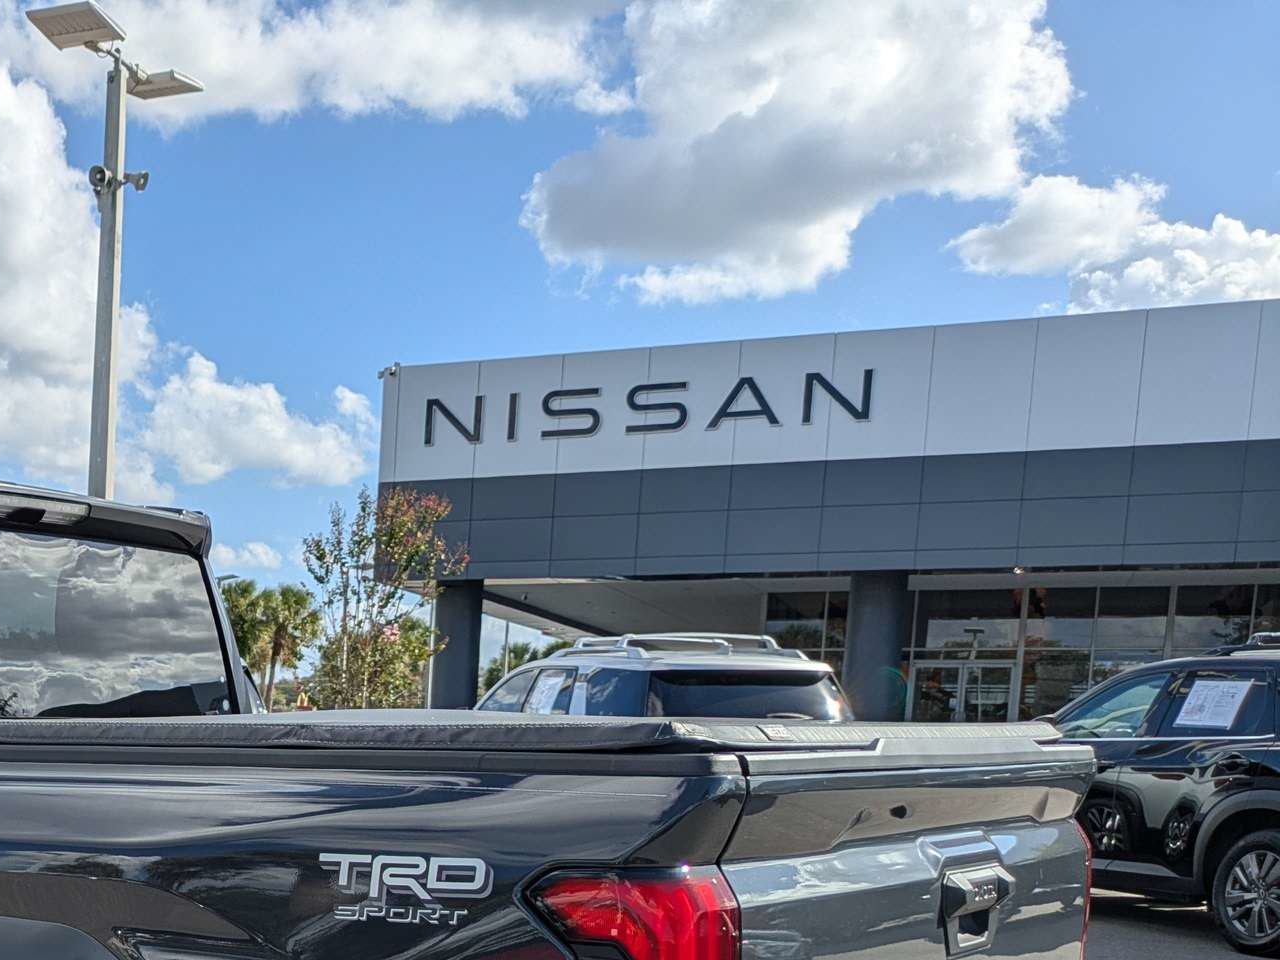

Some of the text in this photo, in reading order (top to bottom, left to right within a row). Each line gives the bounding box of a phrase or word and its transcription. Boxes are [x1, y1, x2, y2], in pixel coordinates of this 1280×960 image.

[424, 368, 875, 446] NISSAN
[319, 853, 492, 901] TRD
[334, 904, 468, 925] SPORT
